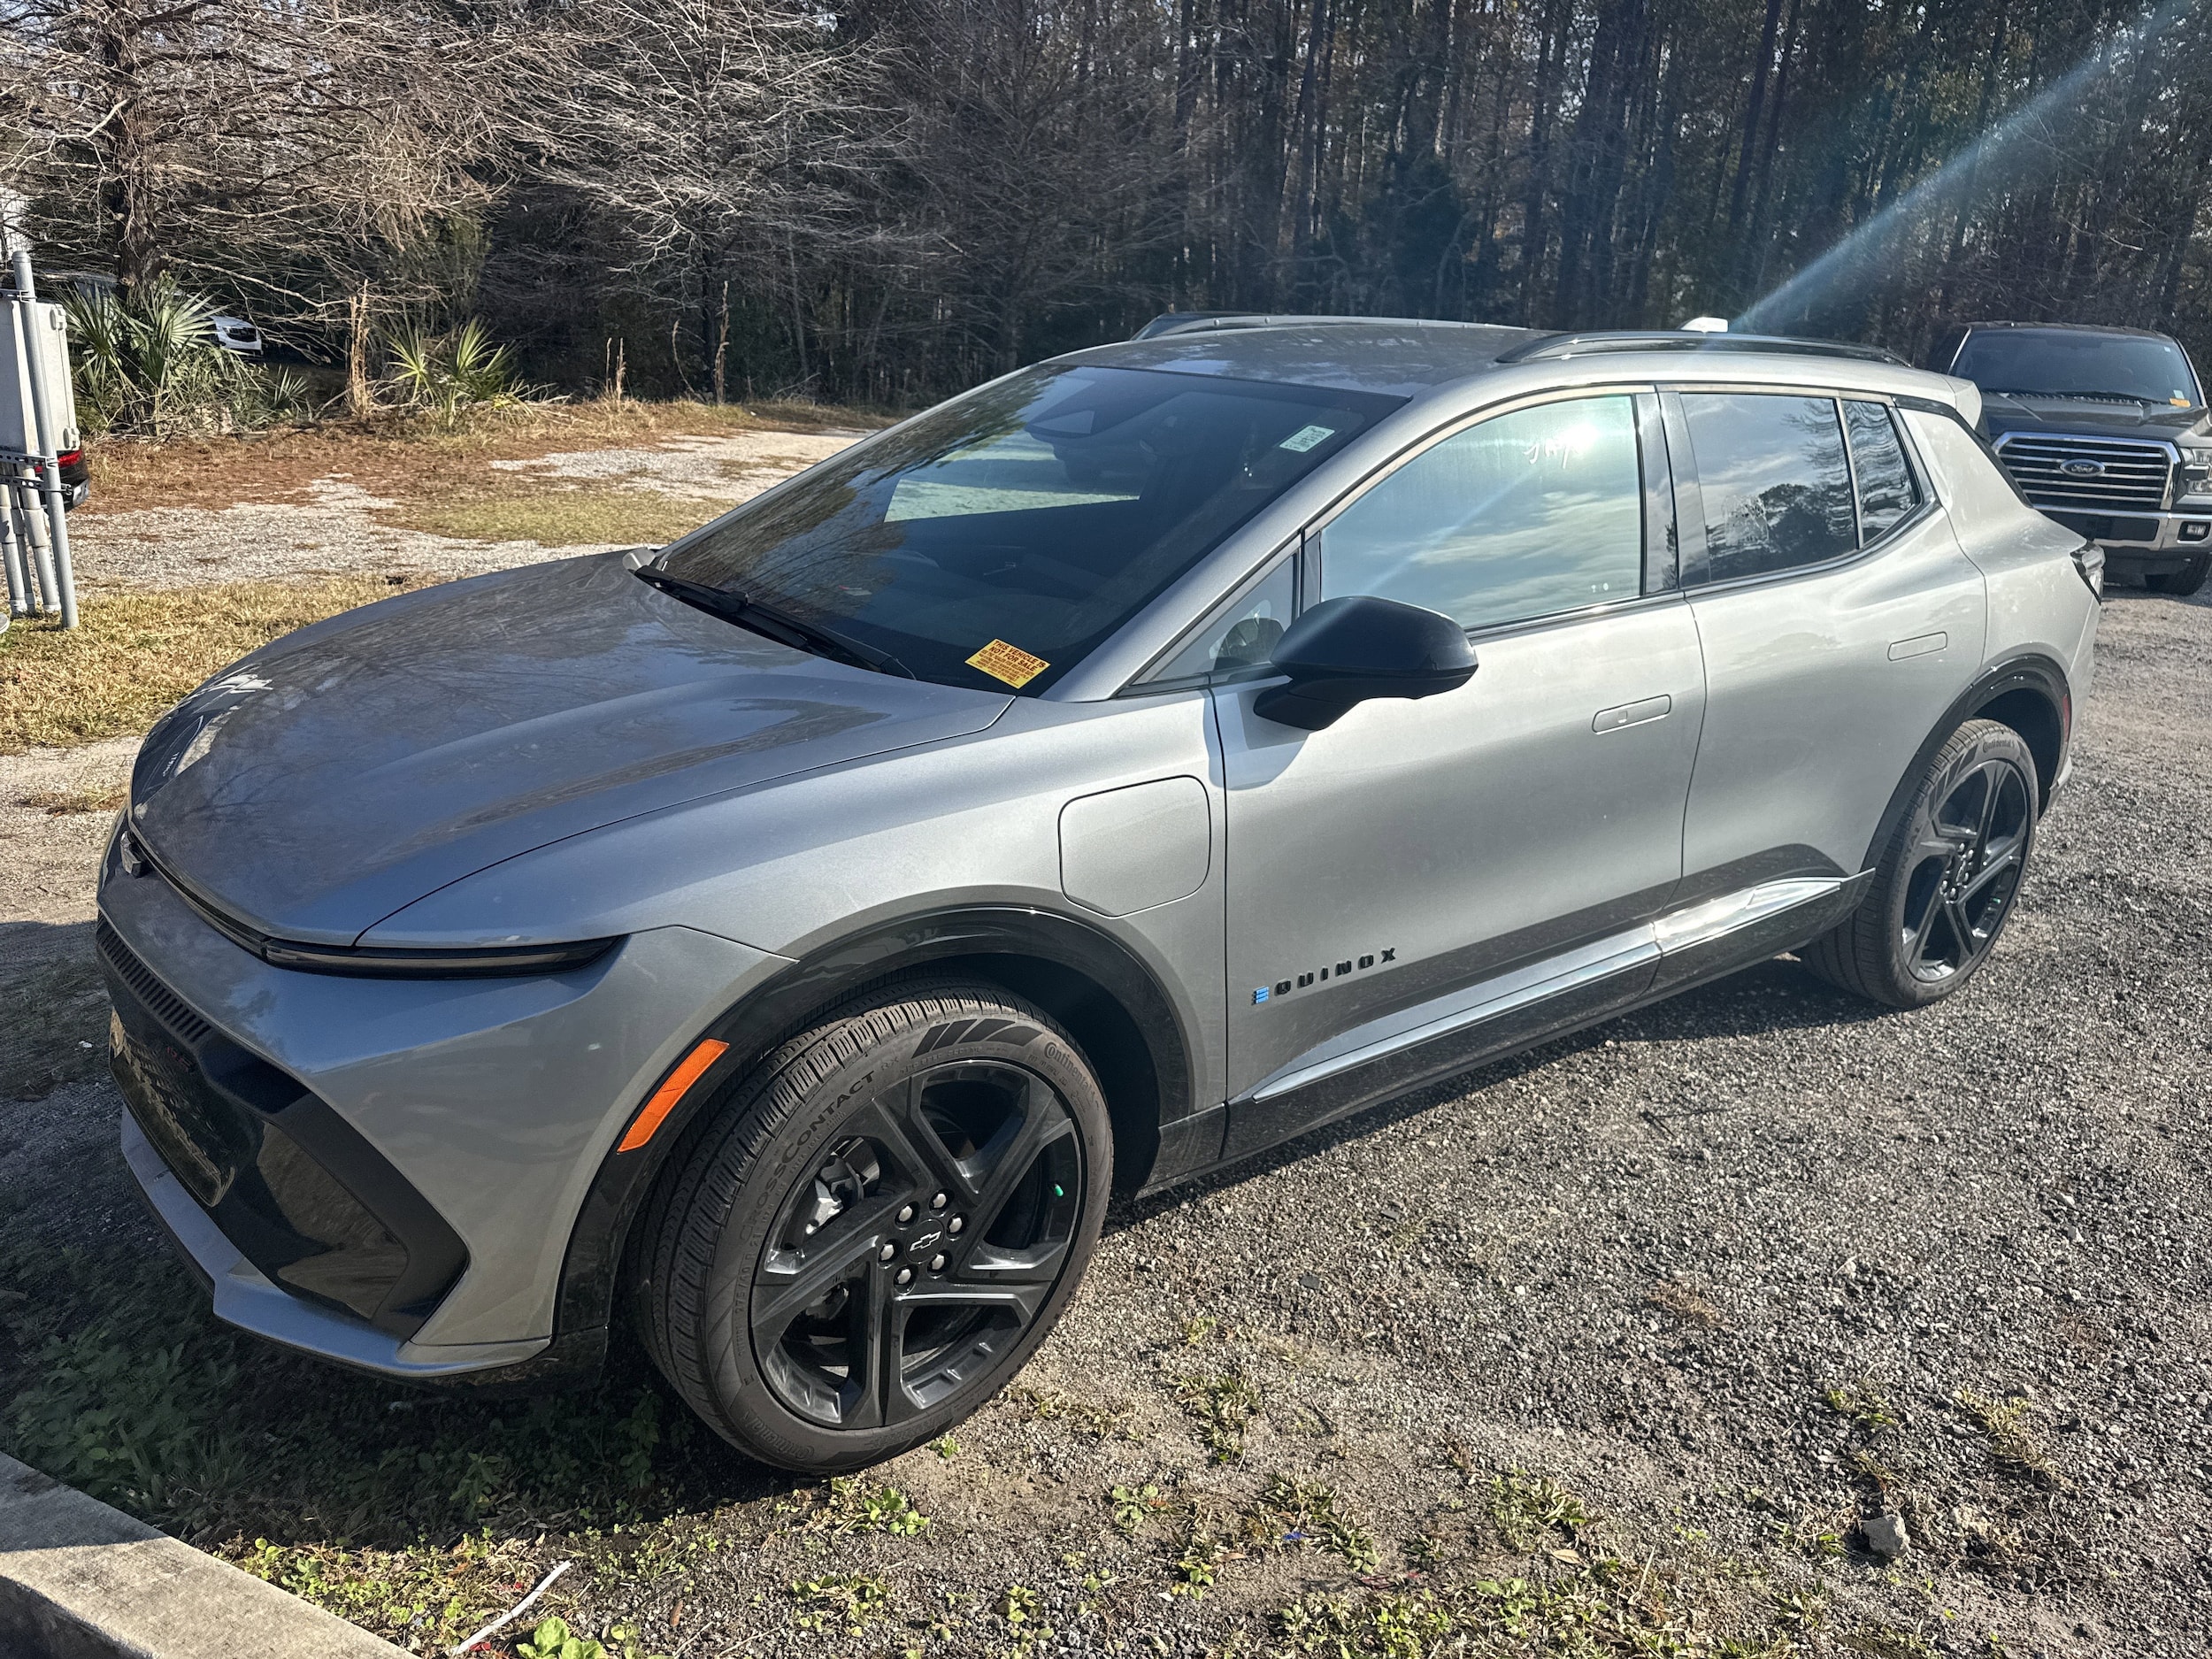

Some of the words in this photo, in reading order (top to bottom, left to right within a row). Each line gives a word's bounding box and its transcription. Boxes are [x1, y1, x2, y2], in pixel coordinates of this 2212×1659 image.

[988, 646, 1005, 656] NOT
[1003, 653, 1019, 663] FOR
[1018, 659, 1039, 672] SALE
[993, 641, 1008, 650] THIS
[1009, 648, 1038, 664] VEHICLE
[1252, 948, 1396, 1005] EQUINOX
[1044, 1041, 1093, 1093] Continental
